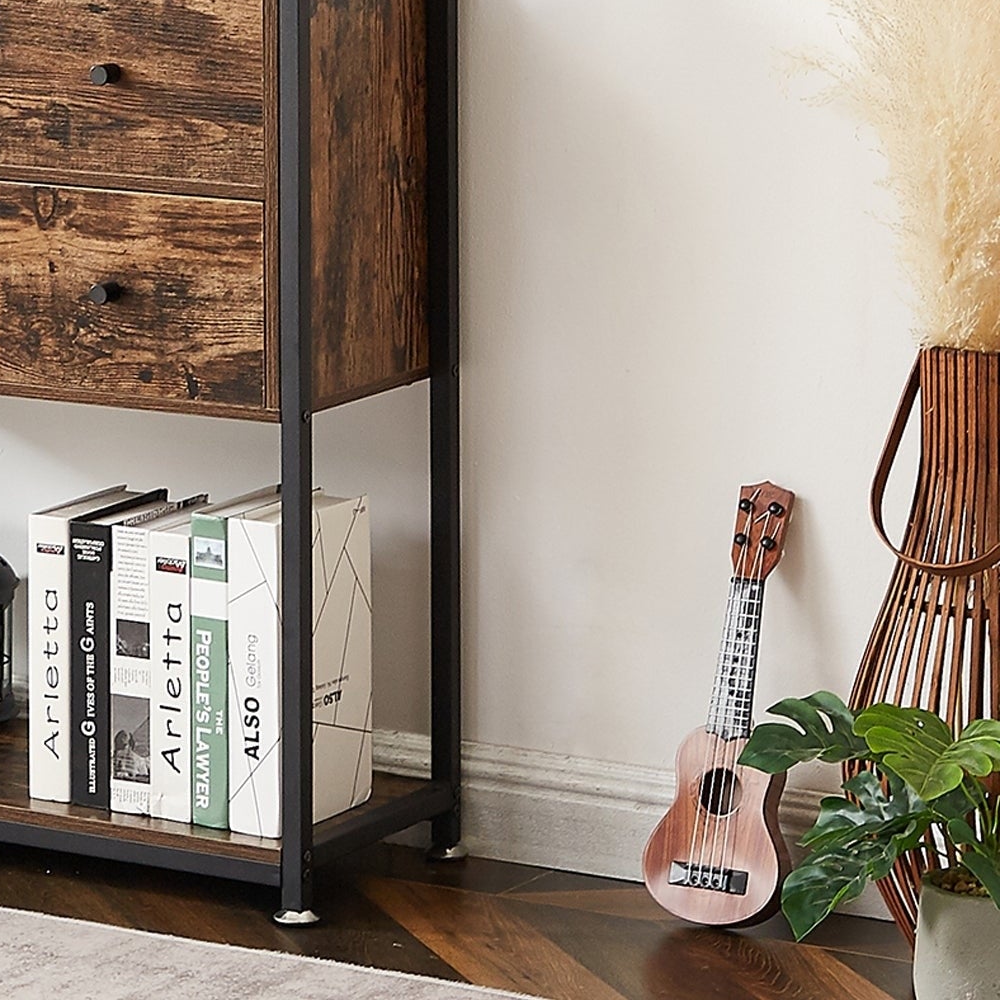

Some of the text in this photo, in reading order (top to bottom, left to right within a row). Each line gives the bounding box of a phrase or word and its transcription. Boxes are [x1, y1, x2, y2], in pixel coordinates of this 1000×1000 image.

[43, 590, 59, 759] Arletta
[86, 676, 95, 692] OF
[159, 603, 182, 773] Arletta
[196, 629, 213, 809] PEOPLE'S LAWYER
[244, 634, 260, 760] ALSO Gelang
[323, 690, 342, 706] ALSO
[88, 738, 97, 794] ILLUSTRATED
[215, 710, 223, 735] THE
